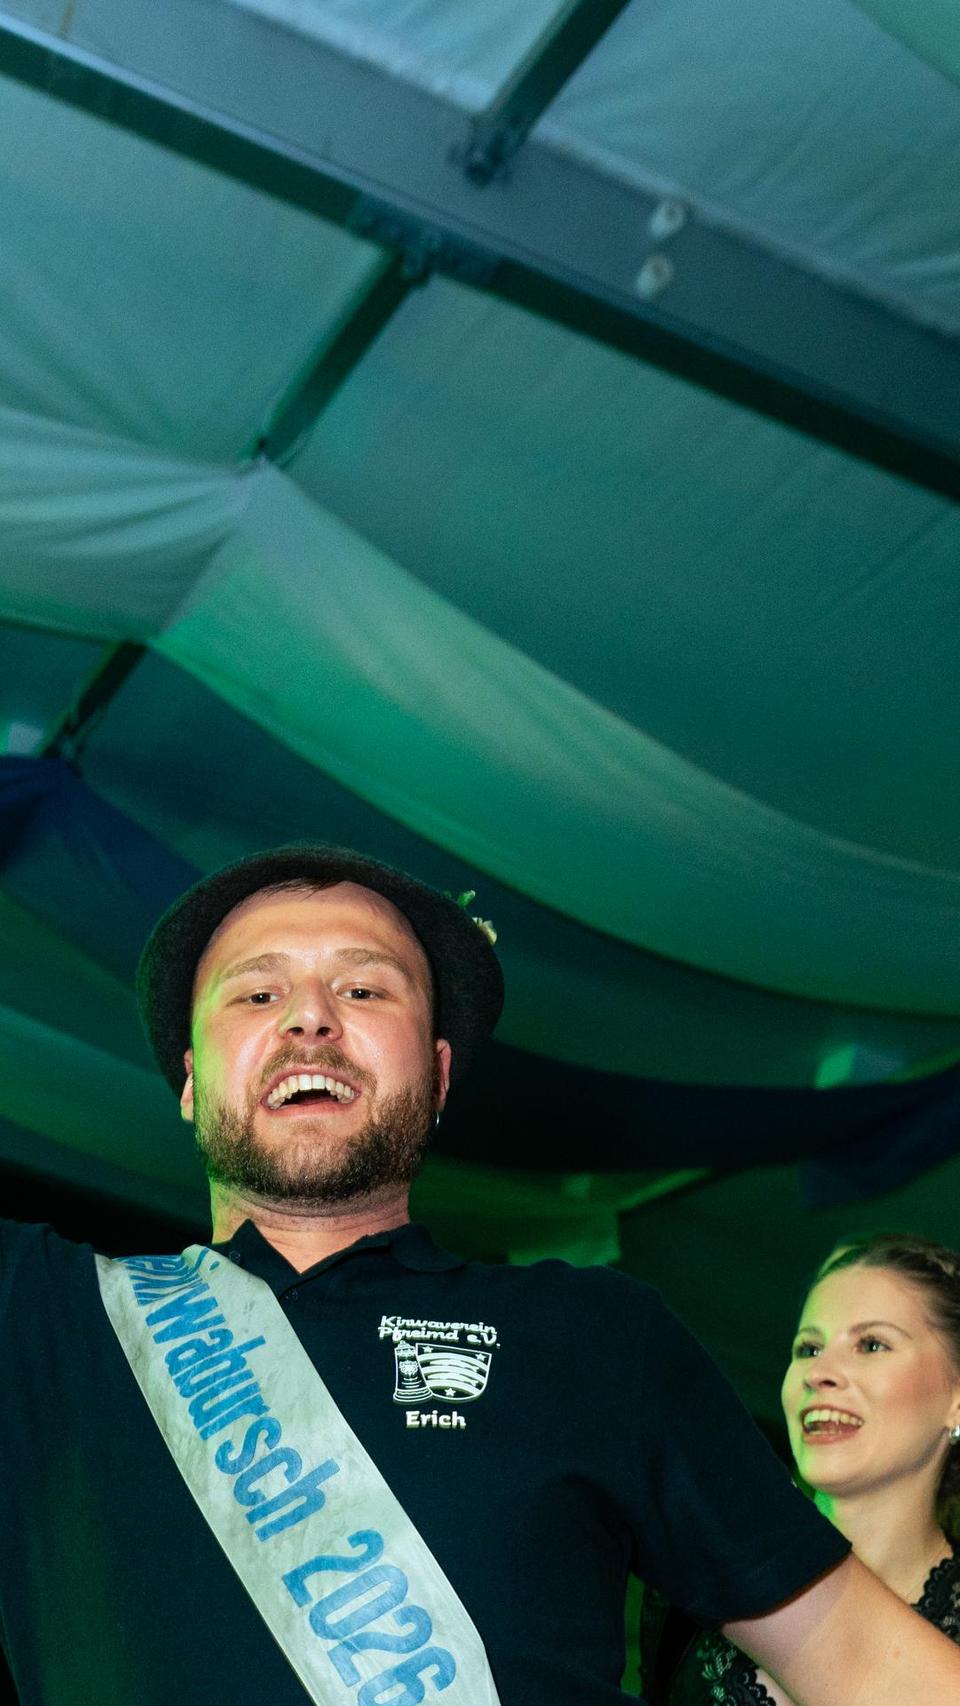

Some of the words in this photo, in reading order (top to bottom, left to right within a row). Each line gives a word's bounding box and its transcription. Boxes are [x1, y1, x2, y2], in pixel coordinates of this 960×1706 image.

[380, 1315, 497, 1334] Kirwaverein
[378, 1327, 459, 1343] Pfreimd
[406, 1410, 466, 1429] Erich
